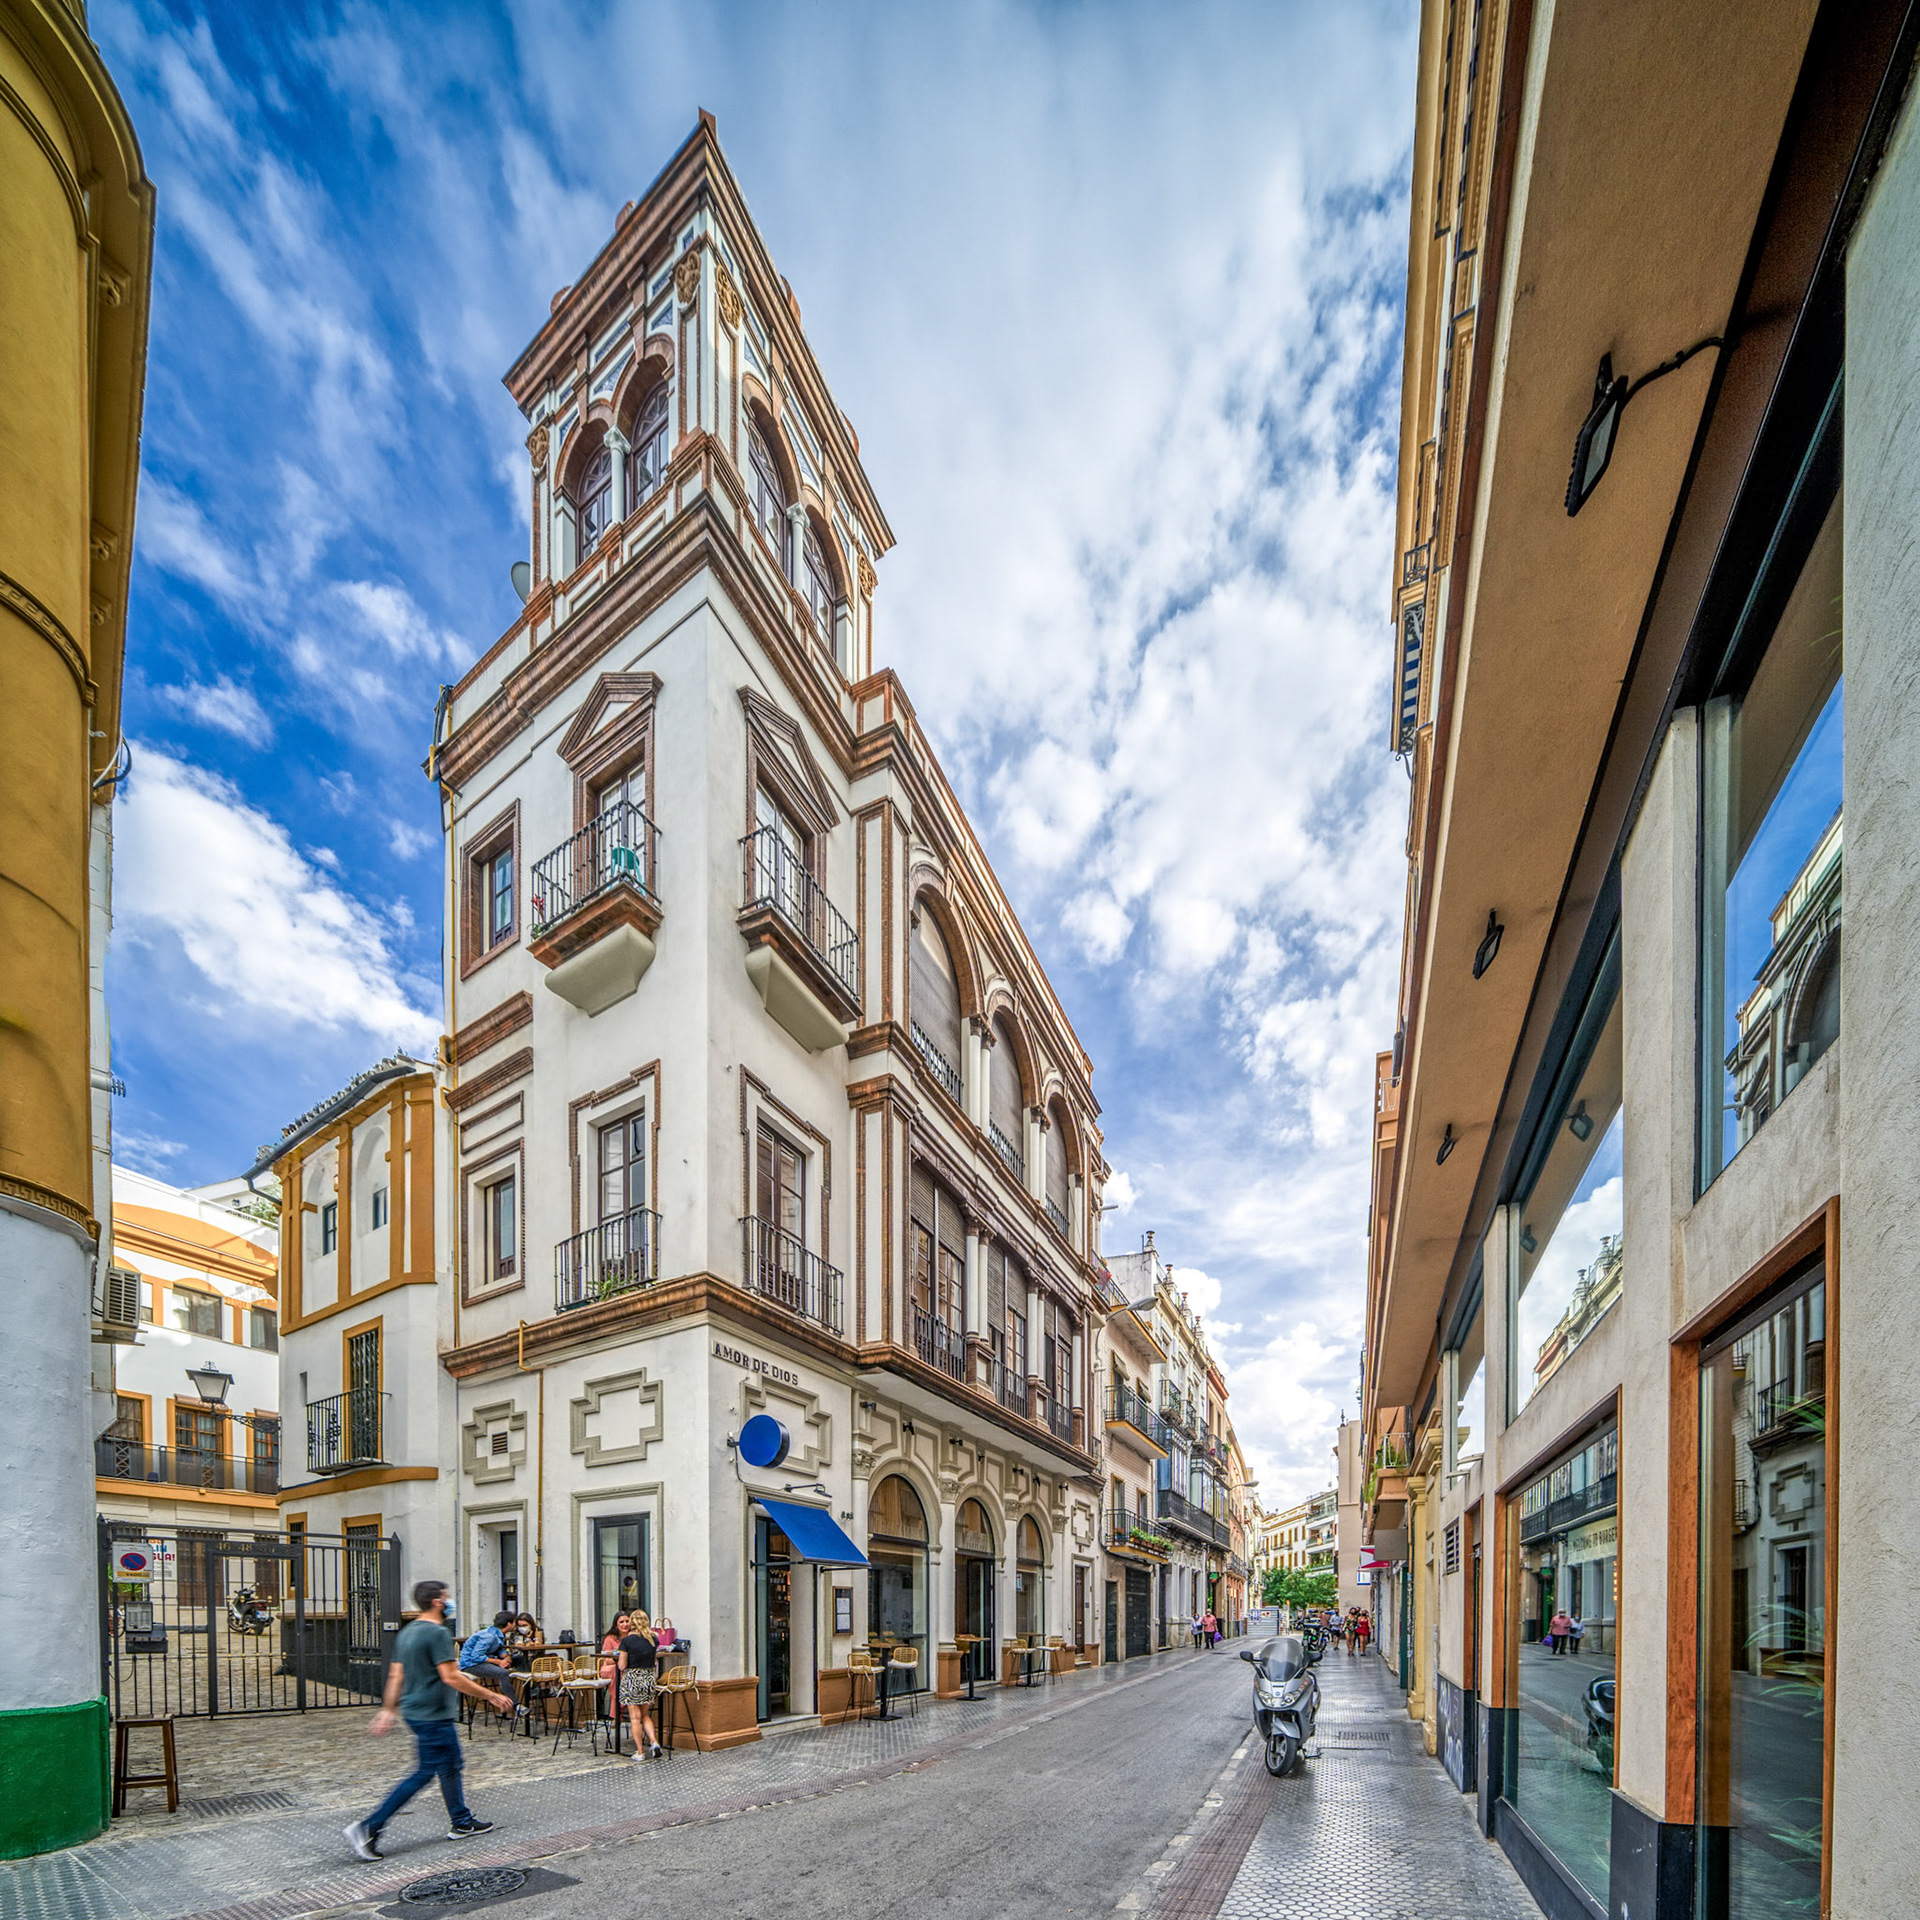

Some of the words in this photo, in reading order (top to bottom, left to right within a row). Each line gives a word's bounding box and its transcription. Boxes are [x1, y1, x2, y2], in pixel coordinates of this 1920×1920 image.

[715, 1343, 750, 1368] AMOR
[751, 1357, 769, 1375] DE
[771, 1365, 798, 1386] DIOS
[217, 1542, 231, 1551] 46
[238, 1543, 253, 1552] 48
